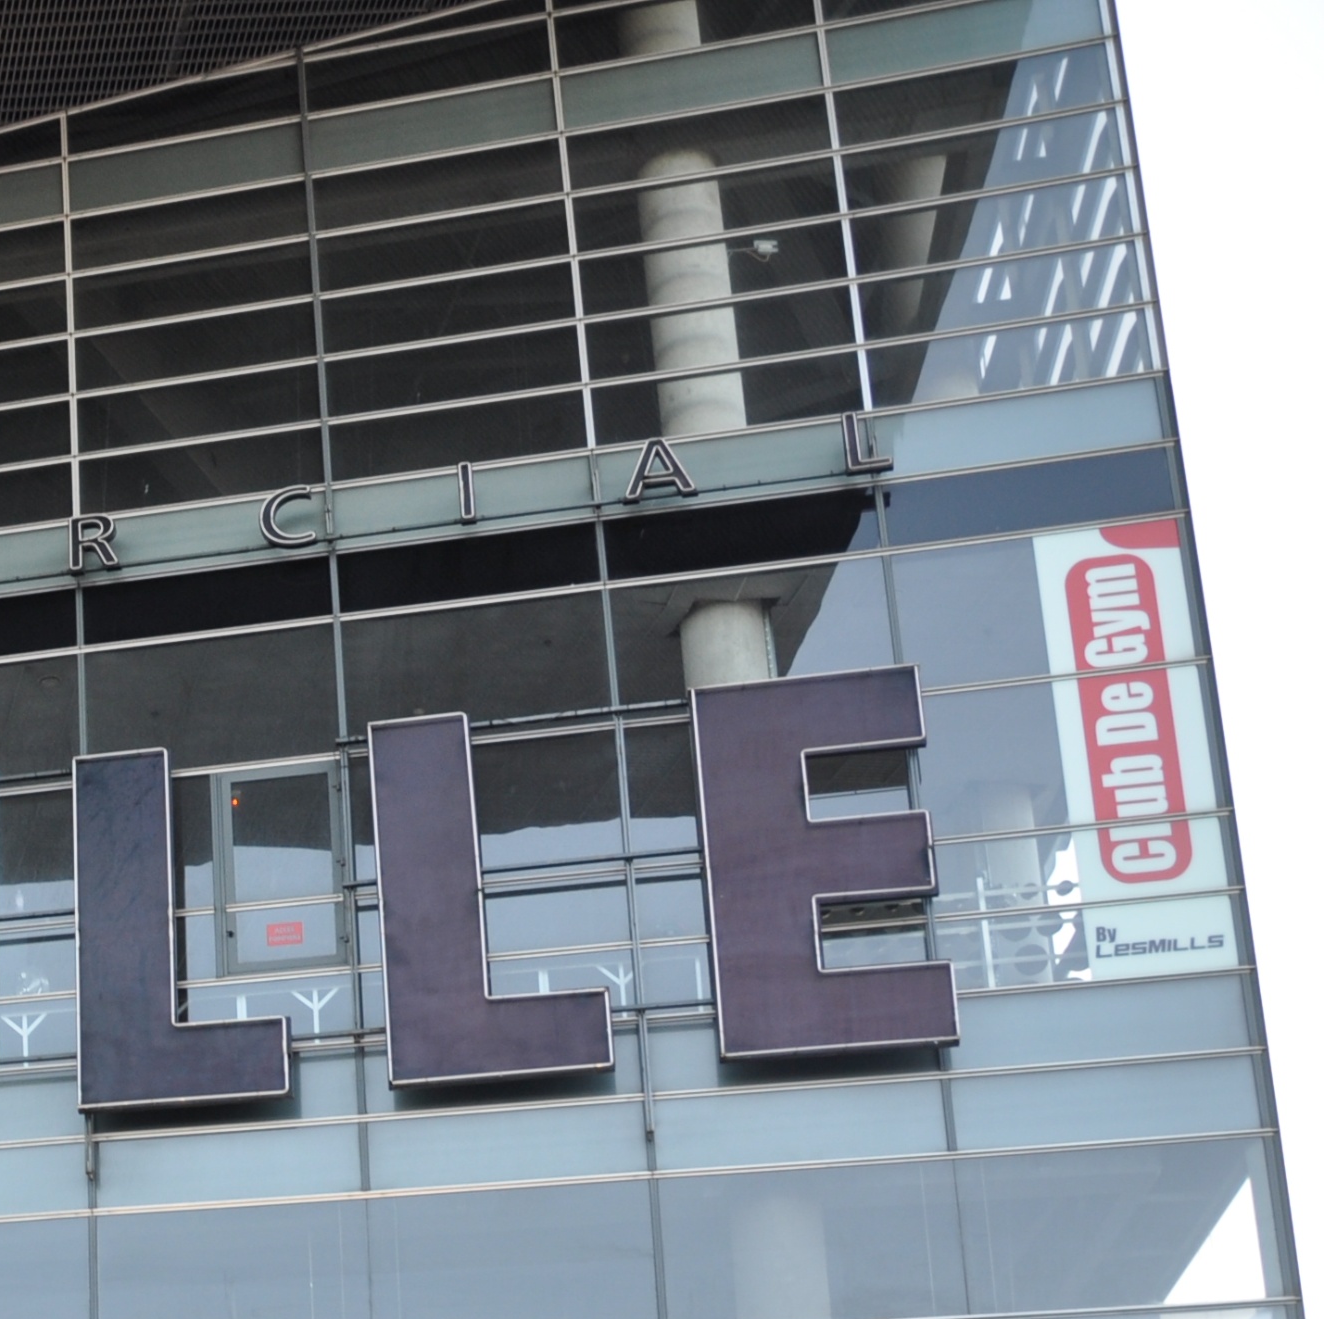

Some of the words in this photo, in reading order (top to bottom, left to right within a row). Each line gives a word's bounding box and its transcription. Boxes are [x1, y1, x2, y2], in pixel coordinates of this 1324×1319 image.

[1083, 562, 1152, 669] Gym
[1094, 679, 1161, 747] De
[1101, 753, 1178, 876] Club
[1095, 926, 1118, 945] By
